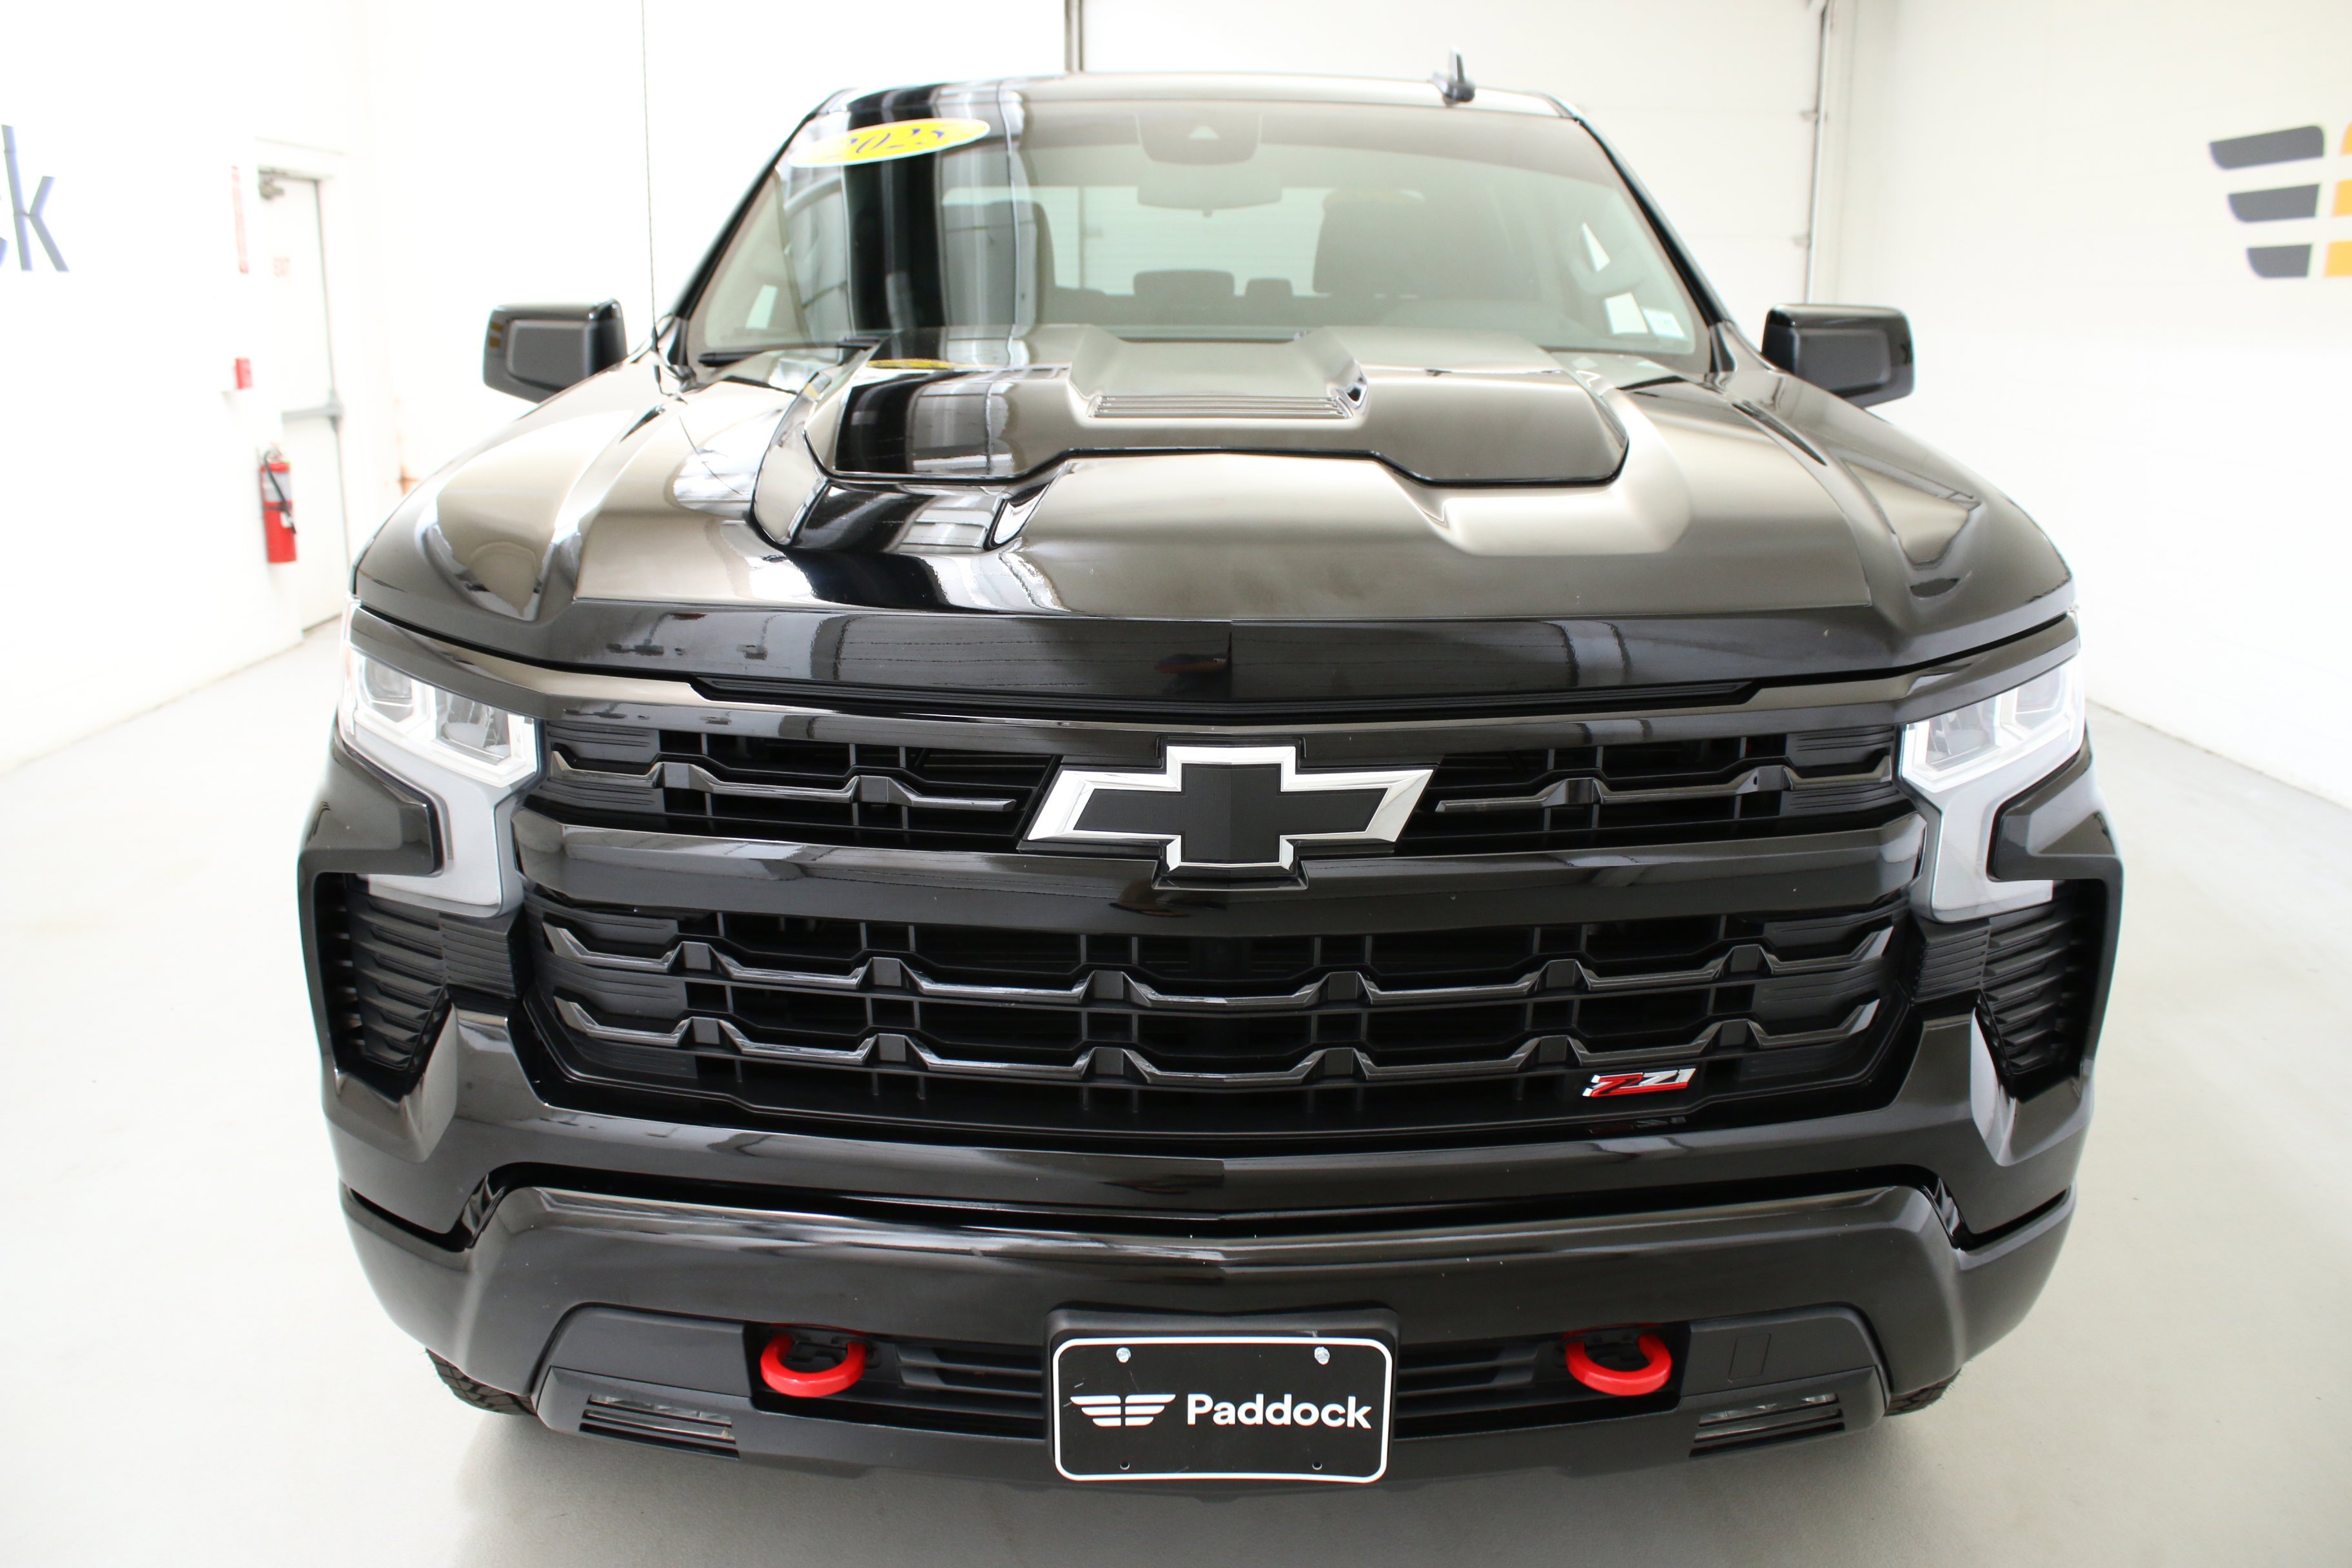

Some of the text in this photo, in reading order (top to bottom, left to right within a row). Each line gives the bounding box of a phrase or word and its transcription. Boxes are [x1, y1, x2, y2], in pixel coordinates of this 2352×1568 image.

[0, 124, 70, 272] k
[1582, 1068, 1696, 1097] Z71
[1187, 1393, 1372, 1429] Paddock
